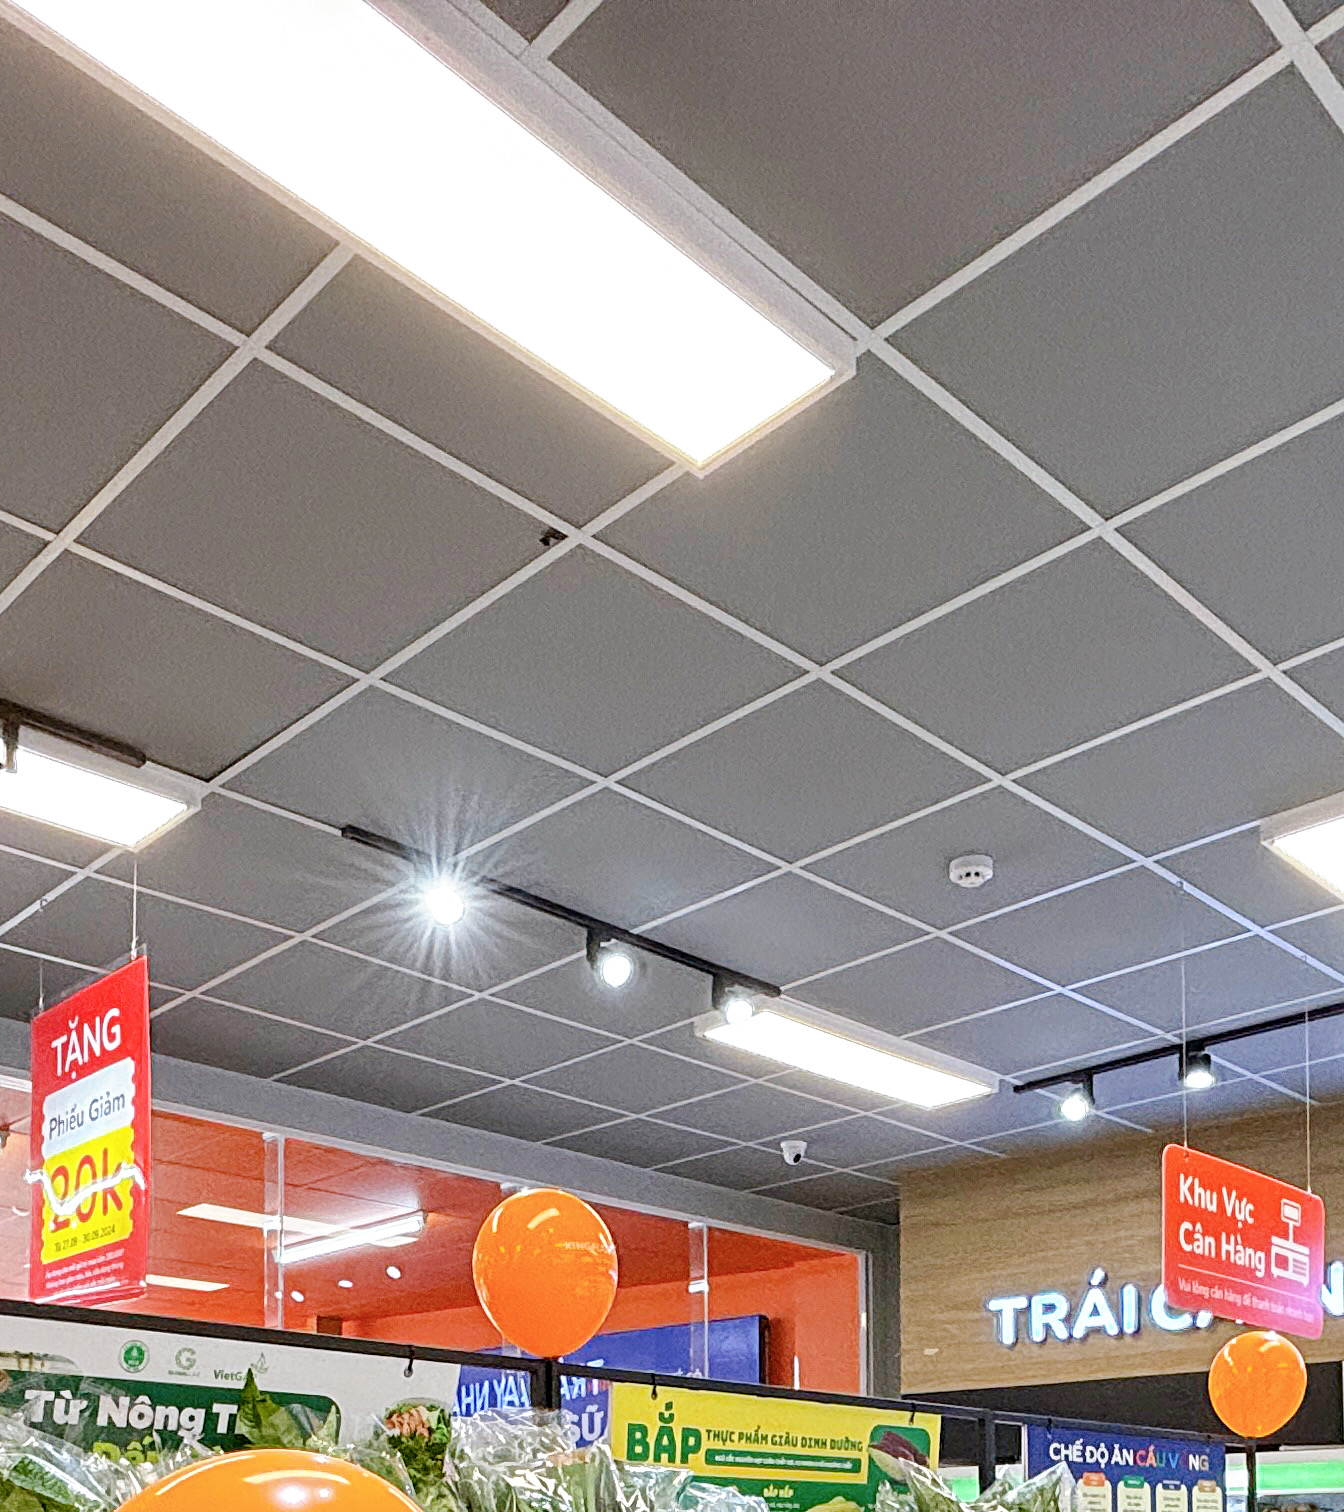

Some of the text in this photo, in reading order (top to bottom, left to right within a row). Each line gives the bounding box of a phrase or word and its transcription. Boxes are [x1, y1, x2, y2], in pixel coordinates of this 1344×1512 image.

[51, 1007, 121, 1080] TẶNG
[49, 1091, 126, 1141] Phiếu Giảm
[1179, 1173, 1255, 1229] Khu Vực
[1179, 1221, 1265, 1277] Cân Hàng
[988, 1267, 1137, 1346] TRÁI
[25, 1390, 87, 1425] Từ
[97, 1395, 206, 1434] Nông
[626, 1401, 702, 1463] BẮP
[1049, 1439, 1083, 1463] CHẾ
[1085, 1443, 1109, 1469] ĐỘ
[1111, 1444, 1134, 1467] ĂN
